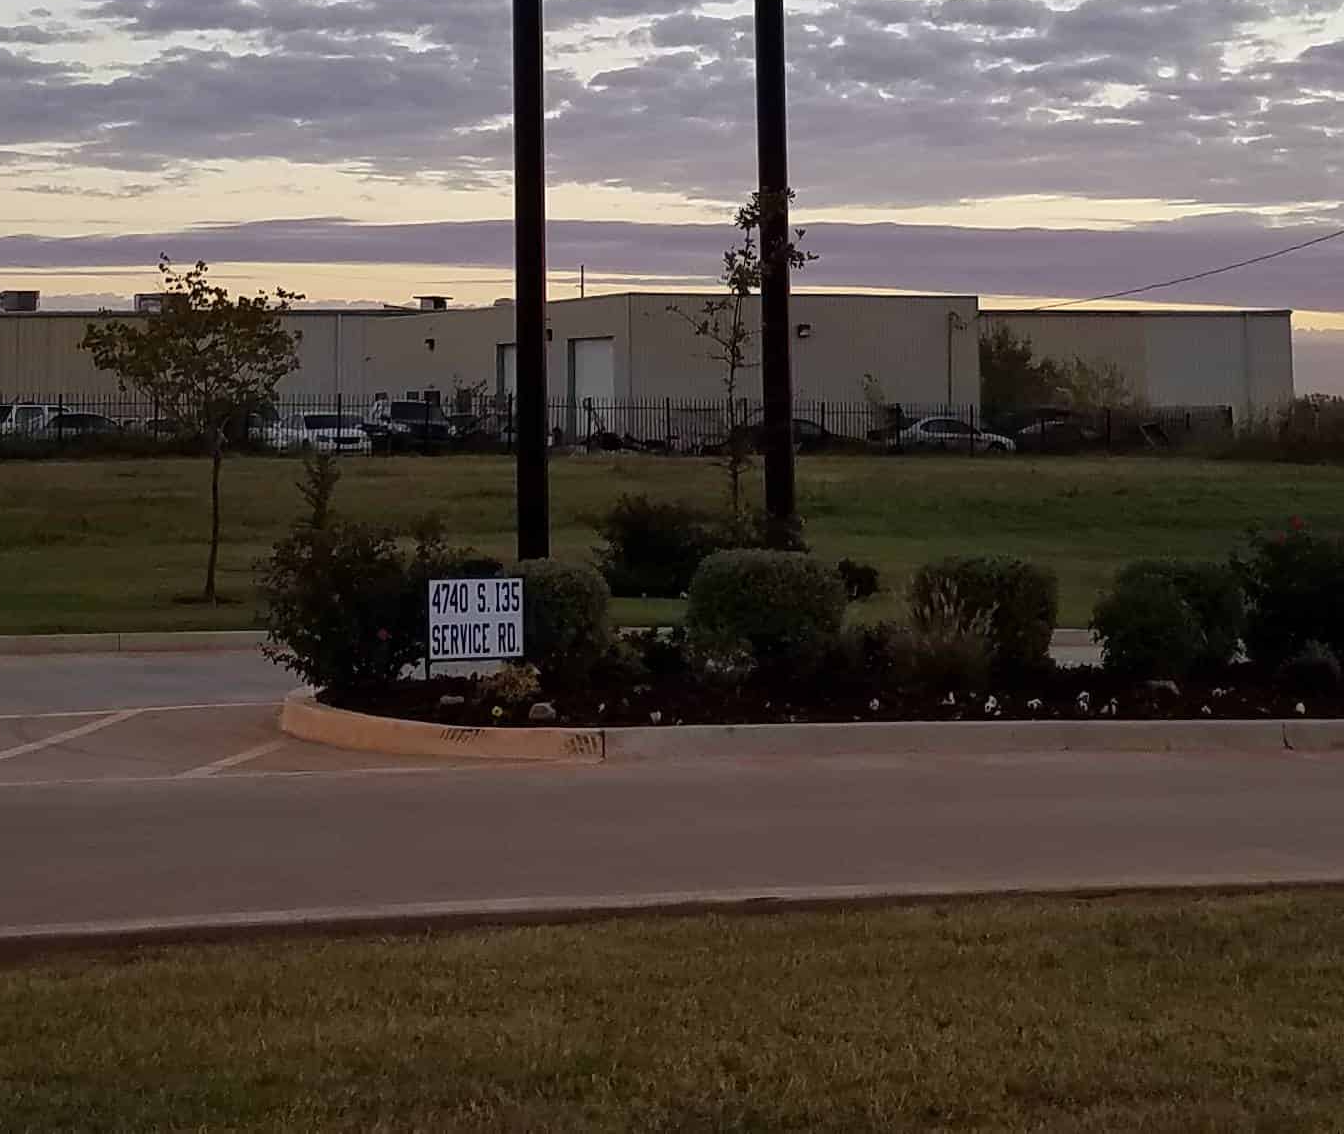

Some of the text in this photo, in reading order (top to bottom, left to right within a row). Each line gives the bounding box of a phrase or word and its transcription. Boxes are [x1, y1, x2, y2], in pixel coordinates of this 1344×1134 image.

[432, 583, 468, 614] 4740
[477, 582, 491, 613] S.
[432, 622, 520, 655] SERVICE RD.
